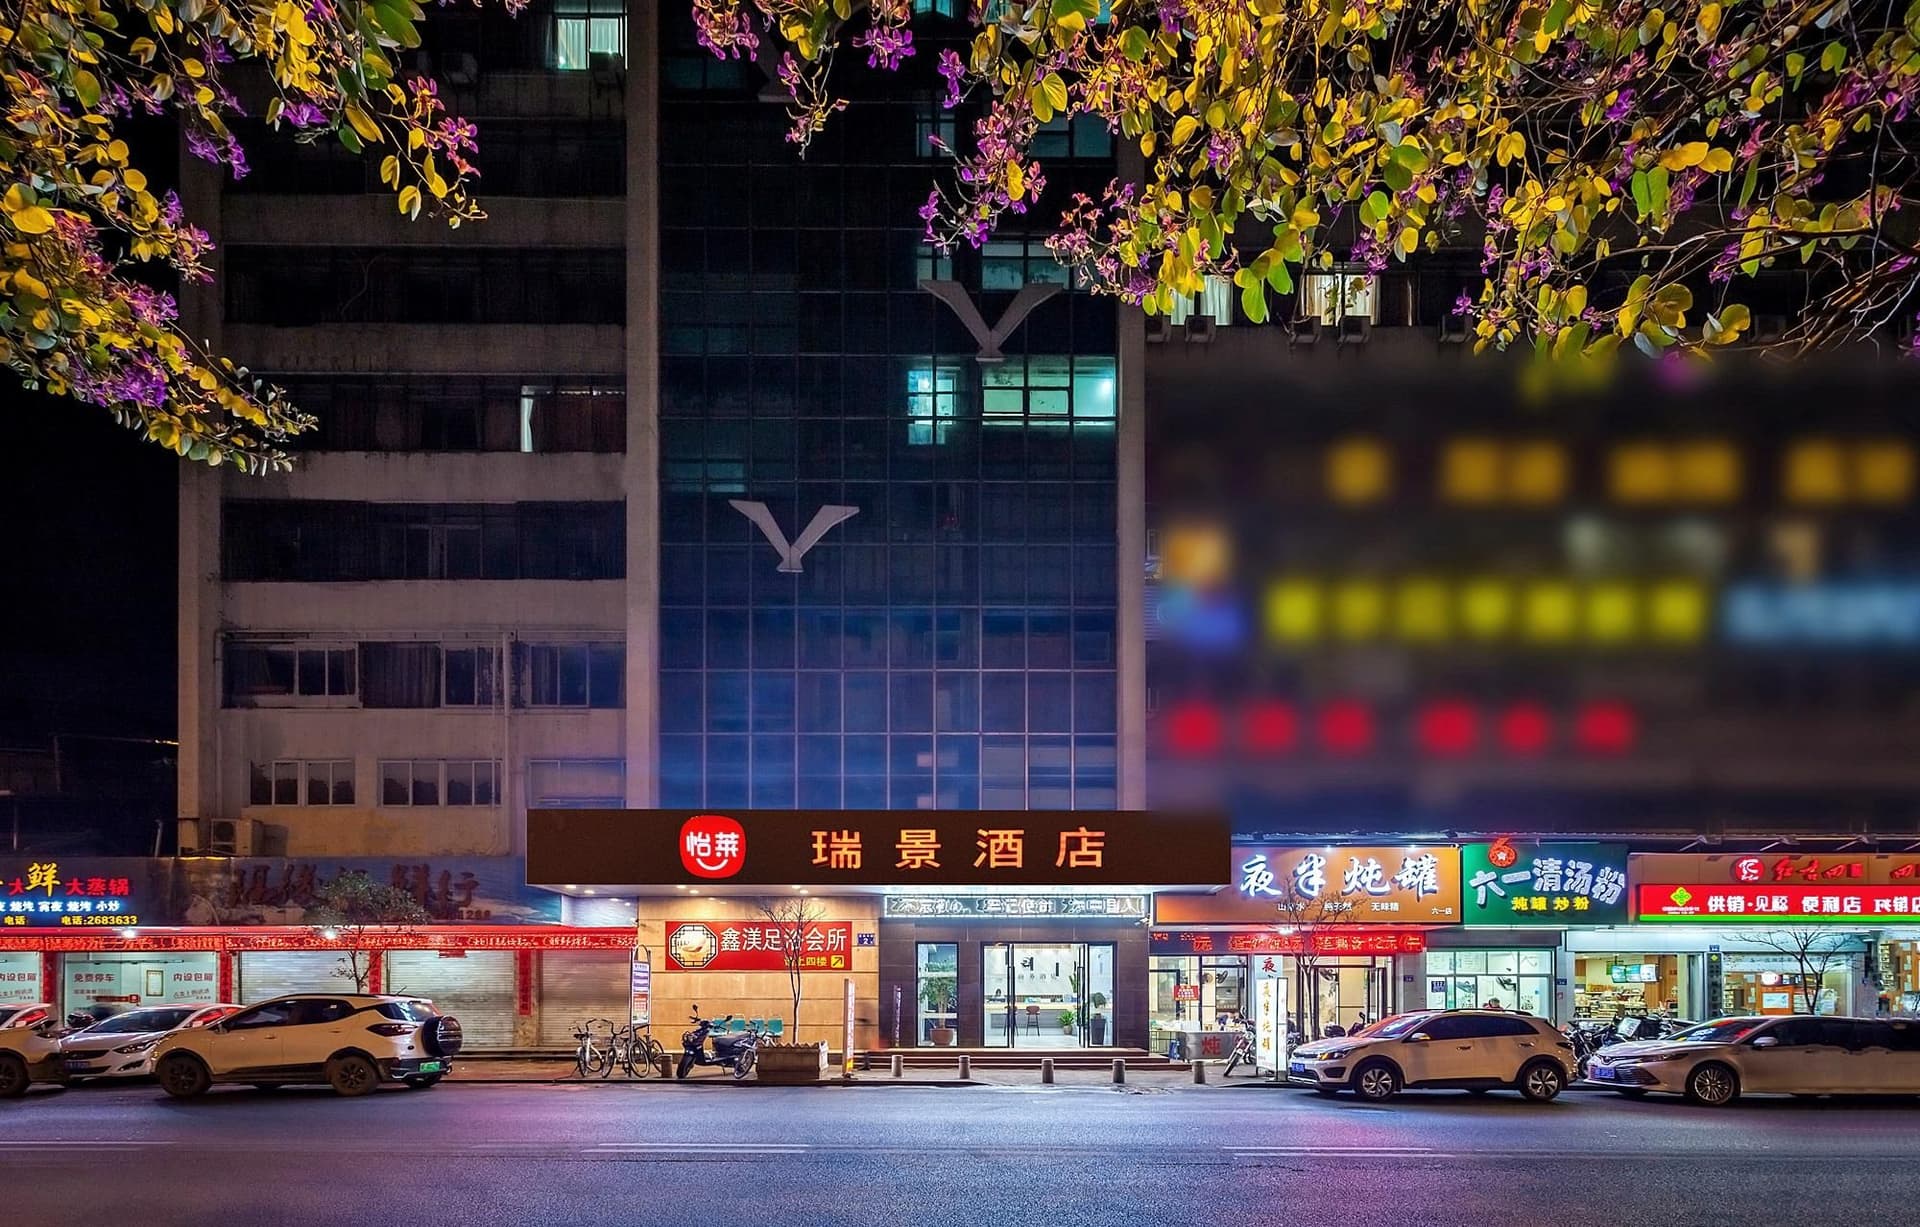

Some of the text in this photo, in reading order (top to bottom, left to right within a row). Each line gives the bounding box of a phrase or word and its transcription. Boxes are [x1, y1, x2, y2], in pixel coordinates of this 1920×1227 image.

[686, 831, 739, 858] 怡莱
[811, 826, 1106, 870] 瑞景酒店
[1240, 853, 1440, 903] 夜半炖罐
[1469, 857, 1625, 905] 六一清汤粉
[1512, 896, 1589, 911] 炖罐 炒粉
[1802, 896, 1861, 913] 便利店
[74, 972, 115, 983] 免费停车
[173, 972, 214, 982] 内设包厢
